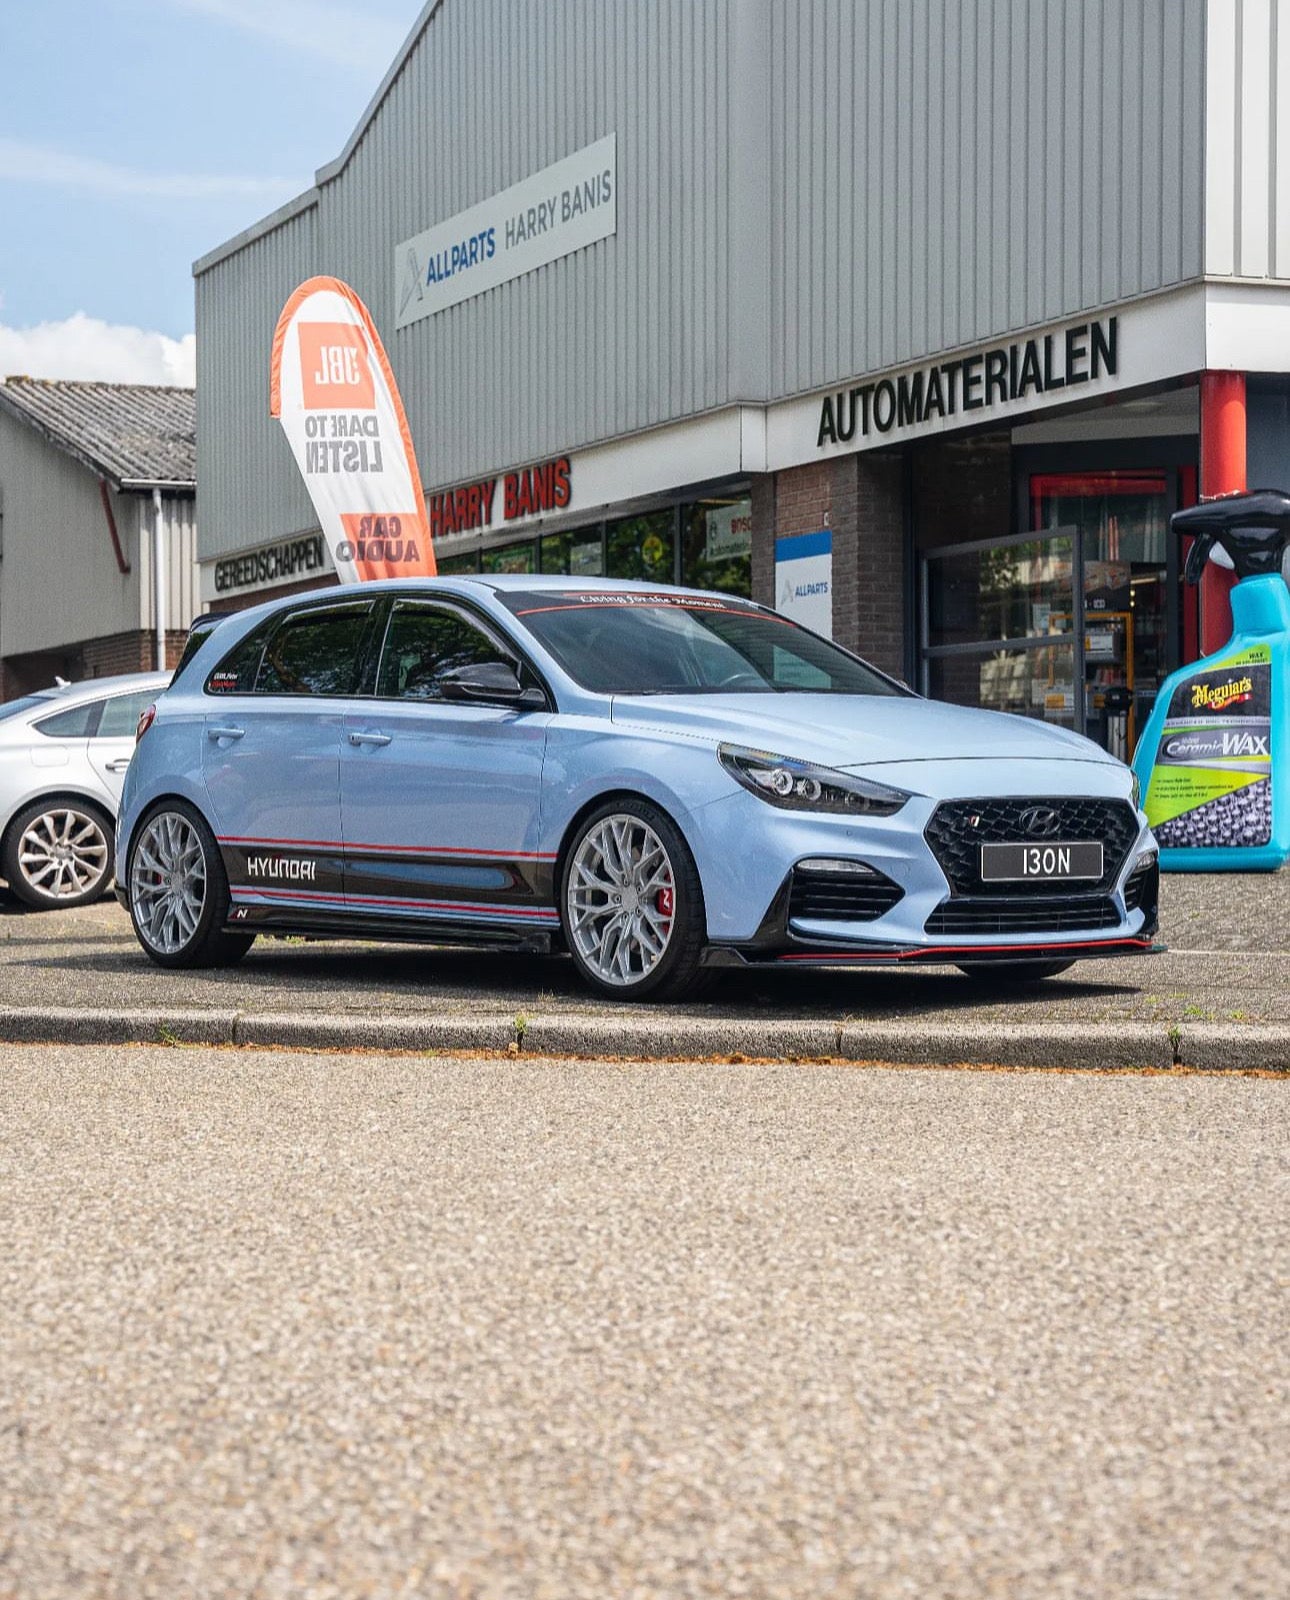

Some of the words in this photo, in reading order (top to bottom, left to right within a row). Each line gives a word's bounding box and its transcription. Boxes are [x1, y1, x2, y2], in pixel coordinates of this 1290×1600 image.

[426, 227, 495, 286] ALLPARTS
[505, 197, 557, 250] HARRY
[561, 169, 612, 223] BANIS
[817, 316, 1117, 447] AUTOMATERIALEN
[430, 479, 496, 538] HARRY
[504, 457, 571, 520] BANIS
[215, 536, 325, 592] GEREEDSCHAPPEN
[795, 582, 828, 597] ALLPARTS
[1191, 676, 1252, 709] Meguiar's
[1222, 732, 1269, 756] WAX
[247, 856, 316, 880] HYUNDAI
[236, 908, 249, 919] N
